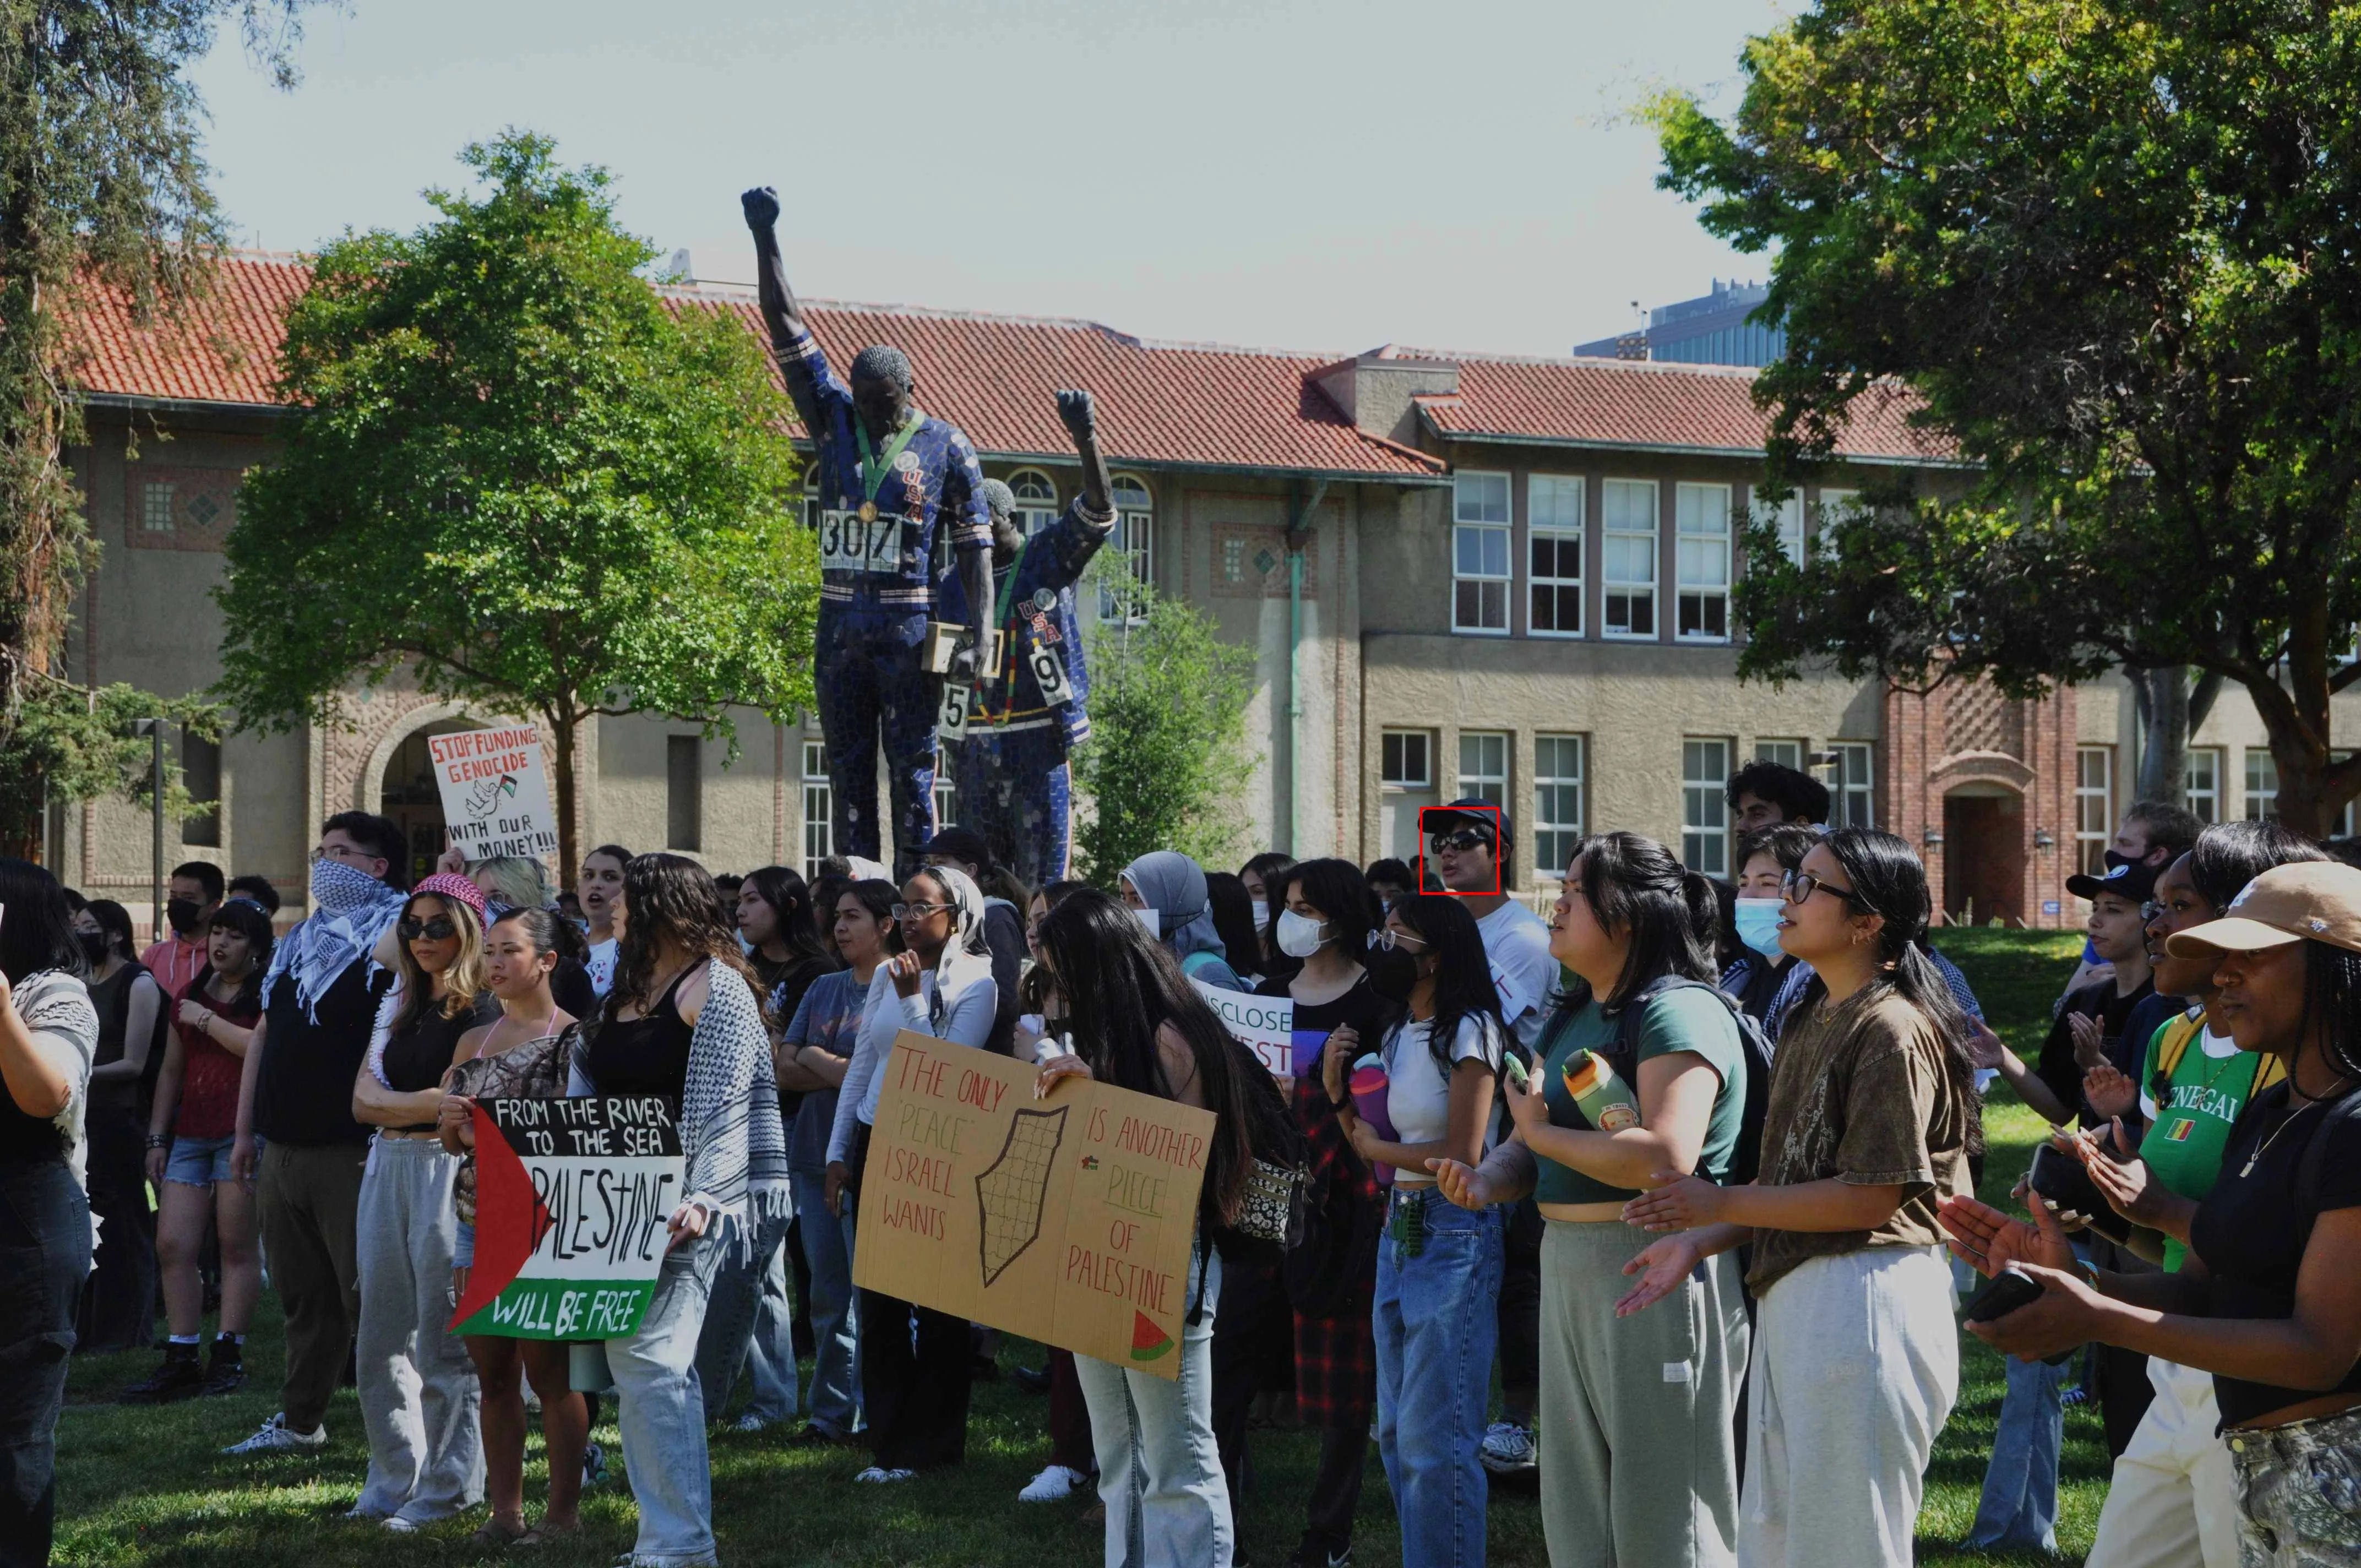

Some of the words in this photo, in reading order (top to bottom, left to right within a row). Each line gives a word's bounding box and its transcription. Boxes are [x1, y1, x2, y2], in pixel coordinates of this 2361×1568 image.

[902, 469, 924, 525] USA
[824, 514, 896, 559] 307
[1018, 600, 1062, 644] USA
[1035, 655, 1060, 692] 9
[939, 688, 964, 728] 5
[431, 733, 471, 763] STOP
[475, 727, 537, 755] FUNDING
[448, 752, 528, 783] GENOCIDE
[448, 821, 489, 841] WITH
[499, 814, 533, 834] OUR
[477, 831, 556, 858] MONEY!!!
[1205, 994, 1292, 1032] ISCLOSE
[896, 1045, 952, 1097] THE
[958, 1069, 1008, 1113] ONLY
[495, 1099, 550, 1127] FROM
[554, 1098, 600, 1125] THE
[607, 1098, 671, 1130] RIVER
[526, 1130, 554, 1155] TO
[568, 1129, 612, 1155] THE
[623, 1126, 663, 1156] SEA
[1087, 1107, 1108, 1142] IS
[1115, 1117, 1201, 1170] ANOTHER
[885, 1146, 955, 1197] ISRAEL
[1108, 1164, 1165, 1215] PIECE
[531, 1167, 673, 1266] PALESTINE
[883, 1194, 945, 1240] WANTS
[1110, 1220, 1140, 1253] OF
[1067, 1245, 1174, 1316] PALESTINE.
[493, 1292, 551, 1330] WILL
[554, 1291, 587, 1337] BE
[586, 1290, 641, 1332] FREE
